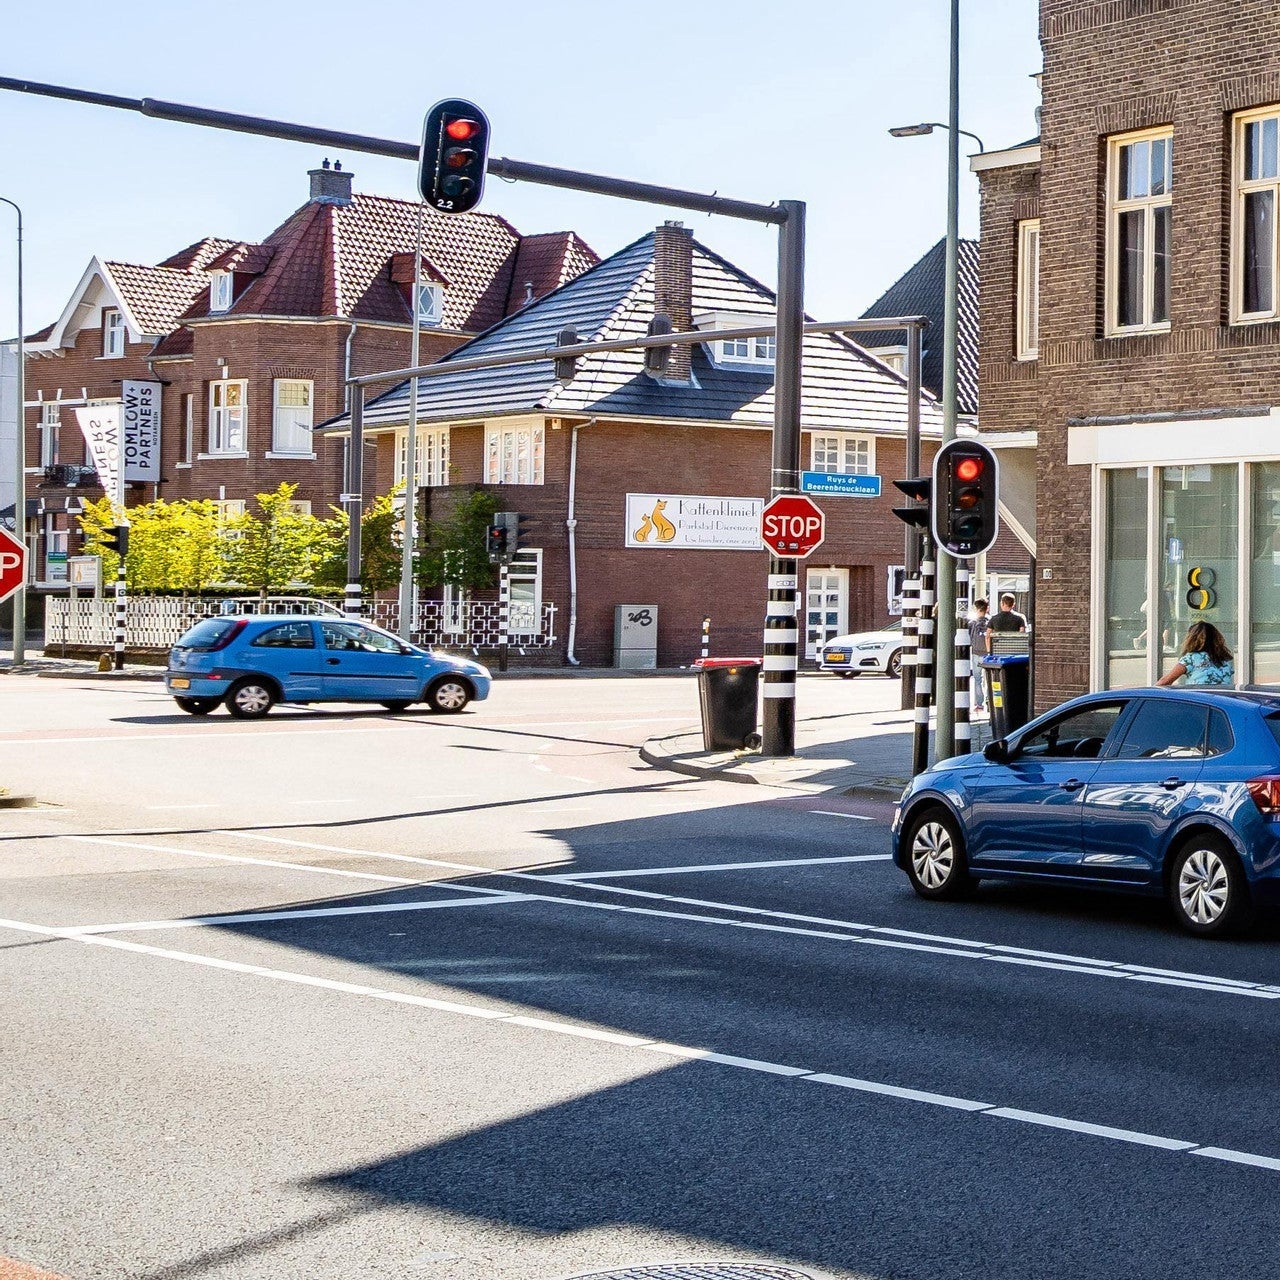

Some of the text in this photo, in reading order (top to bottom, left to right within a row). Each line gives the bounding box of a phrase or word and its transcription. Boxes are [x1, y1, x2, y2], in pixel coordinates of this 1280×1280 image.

[437, 198, 454, 210] 2.2
[139, 387, 152, 468] PARTNERS
[827, 476, 846, 484] Ruys
[807, 483, 876, 493] Beerenbroucklaan
[679, 500, 758, 517] Kattenkliniek
[764, 515, 820, 538] STOP
[959, 542, 971, 550] 2.1
